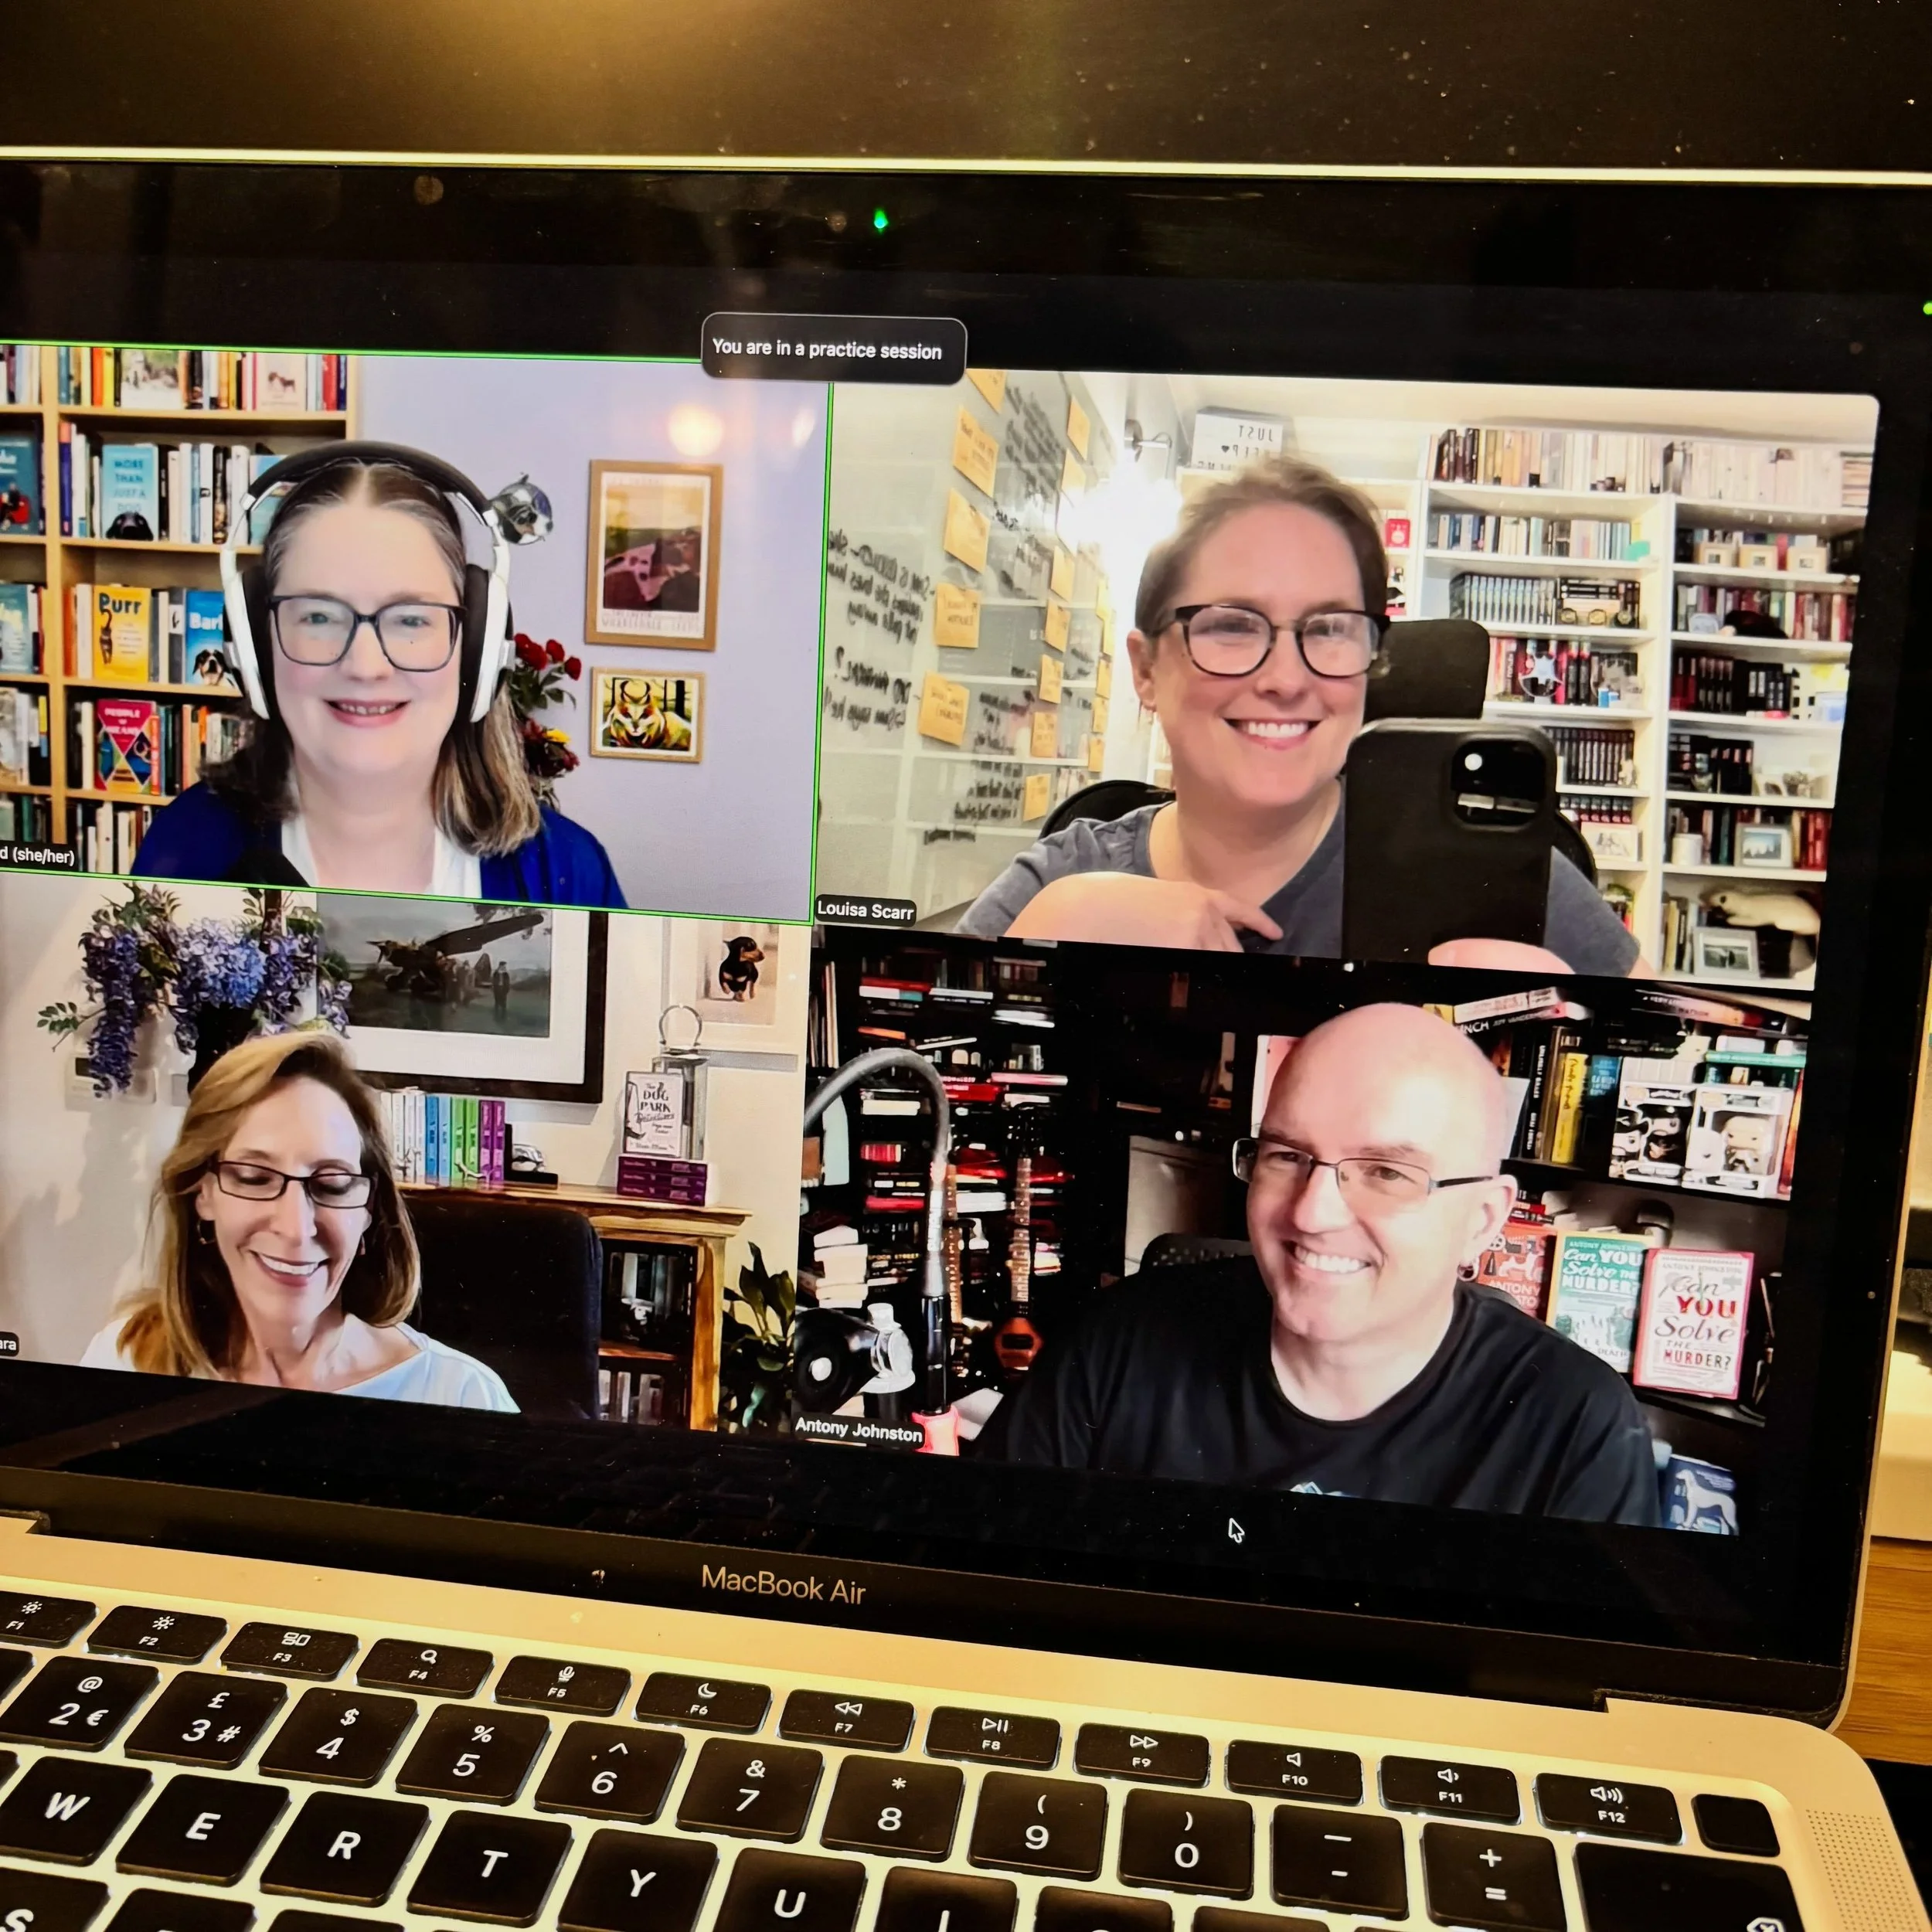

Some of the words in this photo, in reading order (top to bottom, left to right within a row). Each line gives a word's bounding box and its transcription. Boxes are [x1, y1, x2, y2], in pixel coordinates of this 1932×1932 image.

[713, 338, 742, 354] You
[747, 342, 772, 355] are
[777, 339, 791, 355] in
[795, 343, 804, 355] a
[810, 342, 876, 359] practice
[880, 343, 942, 359] session
[99, 593, 142, 614] Purr
[13, 847, 74, 866] (she/her)
[818, 901, 866, 917] Louisa
[872, 904, 914, 920] Scarr
[1459, 1019, 1489, 1034] INCH
[643, 1088, 669, 1101] DOG
[640, 1101, 671, 1113] PARK
[1564, 1248, 1597, 1262] Can
[1599, 1249, 1643, 1266] YOU
[1563, 1261, 1617, 1278] Solve
[1659, 1275, 1719, 1298] Can
[1676, 1295, 1736, 1318] YOU
[1655, 1315, 1736, 1344] Solve
[1664, 1349, 1732, 1372] MURDER?
[795, 1417, 849, 1437] Antony
[852, 1422, 924, 1444] Johnston
[703, 1565, 823, 1599] MacBook
[831, 1580, 866, 1604] Air
[5, 1621, 25, 1630] F1
[138, 1635, 159, 1646] F2
[272, 1652, 293, 1662] F3
[408, 1669, 428, 1680] F4
[547, 1686, 567, 1698] F5
[49, 1703, 80, 1725] 2
[689, 1704, 709, 1716] F6
[182, 1719, 211, 1741] 3
[834, 1722, 854, 1733] F7
[316, 1737, 344, 1759] 4
[981, 1739, 1001, 1750] F8
[453, 1753, 480, 1776] 5
[1131, 1757, 1152, 1767] F9
[592, 1771, 617, 1794] 6
[1281, 1774, 1308, 1786] F10
[46, 1792, 90, 1821] W
[736, 1789, 760, 1811] 7
[1438, 1791, 1463, 1804] F11
[186, 1812, 221, 1840] E
[878, 1808, 902, 1831] 8
[1597, 1810, 1626, 1824] F12
[328, 1831, 360, 1859] R
[1026, 1825, 1049, 1849] 9
[482, 1850, 508, 1877] T
[631, 1869, 656, 1896] Y
[774, 1889, 806, 1917] U
[0, 1909, 33, 1932] S
